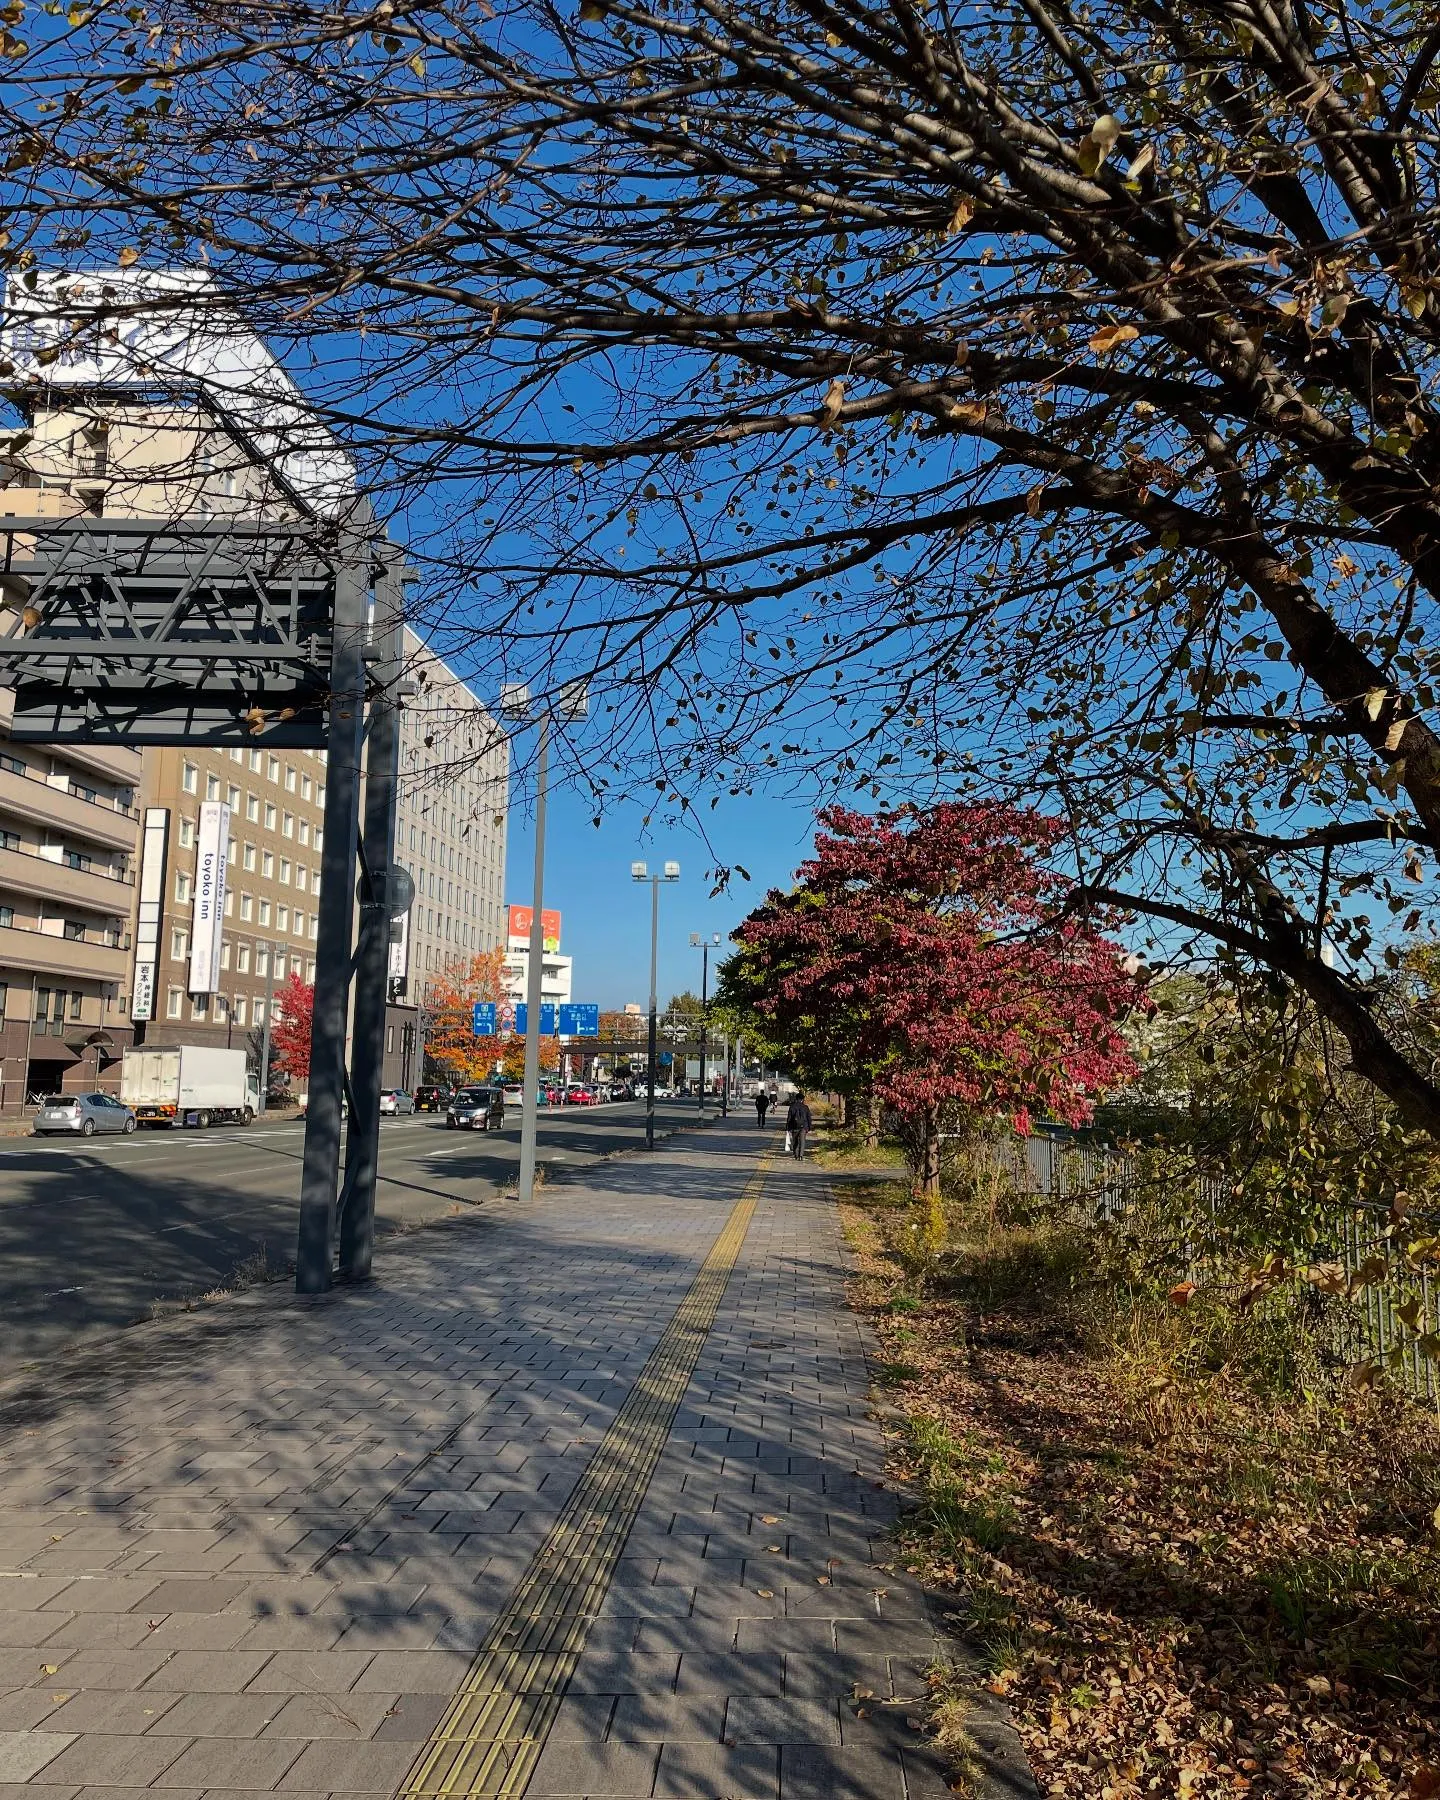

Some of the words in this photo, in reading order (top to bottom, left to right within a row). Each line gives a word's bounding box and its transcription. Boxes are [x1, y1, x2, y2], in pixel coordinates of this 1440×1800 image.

[202, 853, 214, 896] toyoko
[201, 900, 211, 919] inn
[141, 966, 149, 982] 岩本
[394, 978, 401, 987] P
